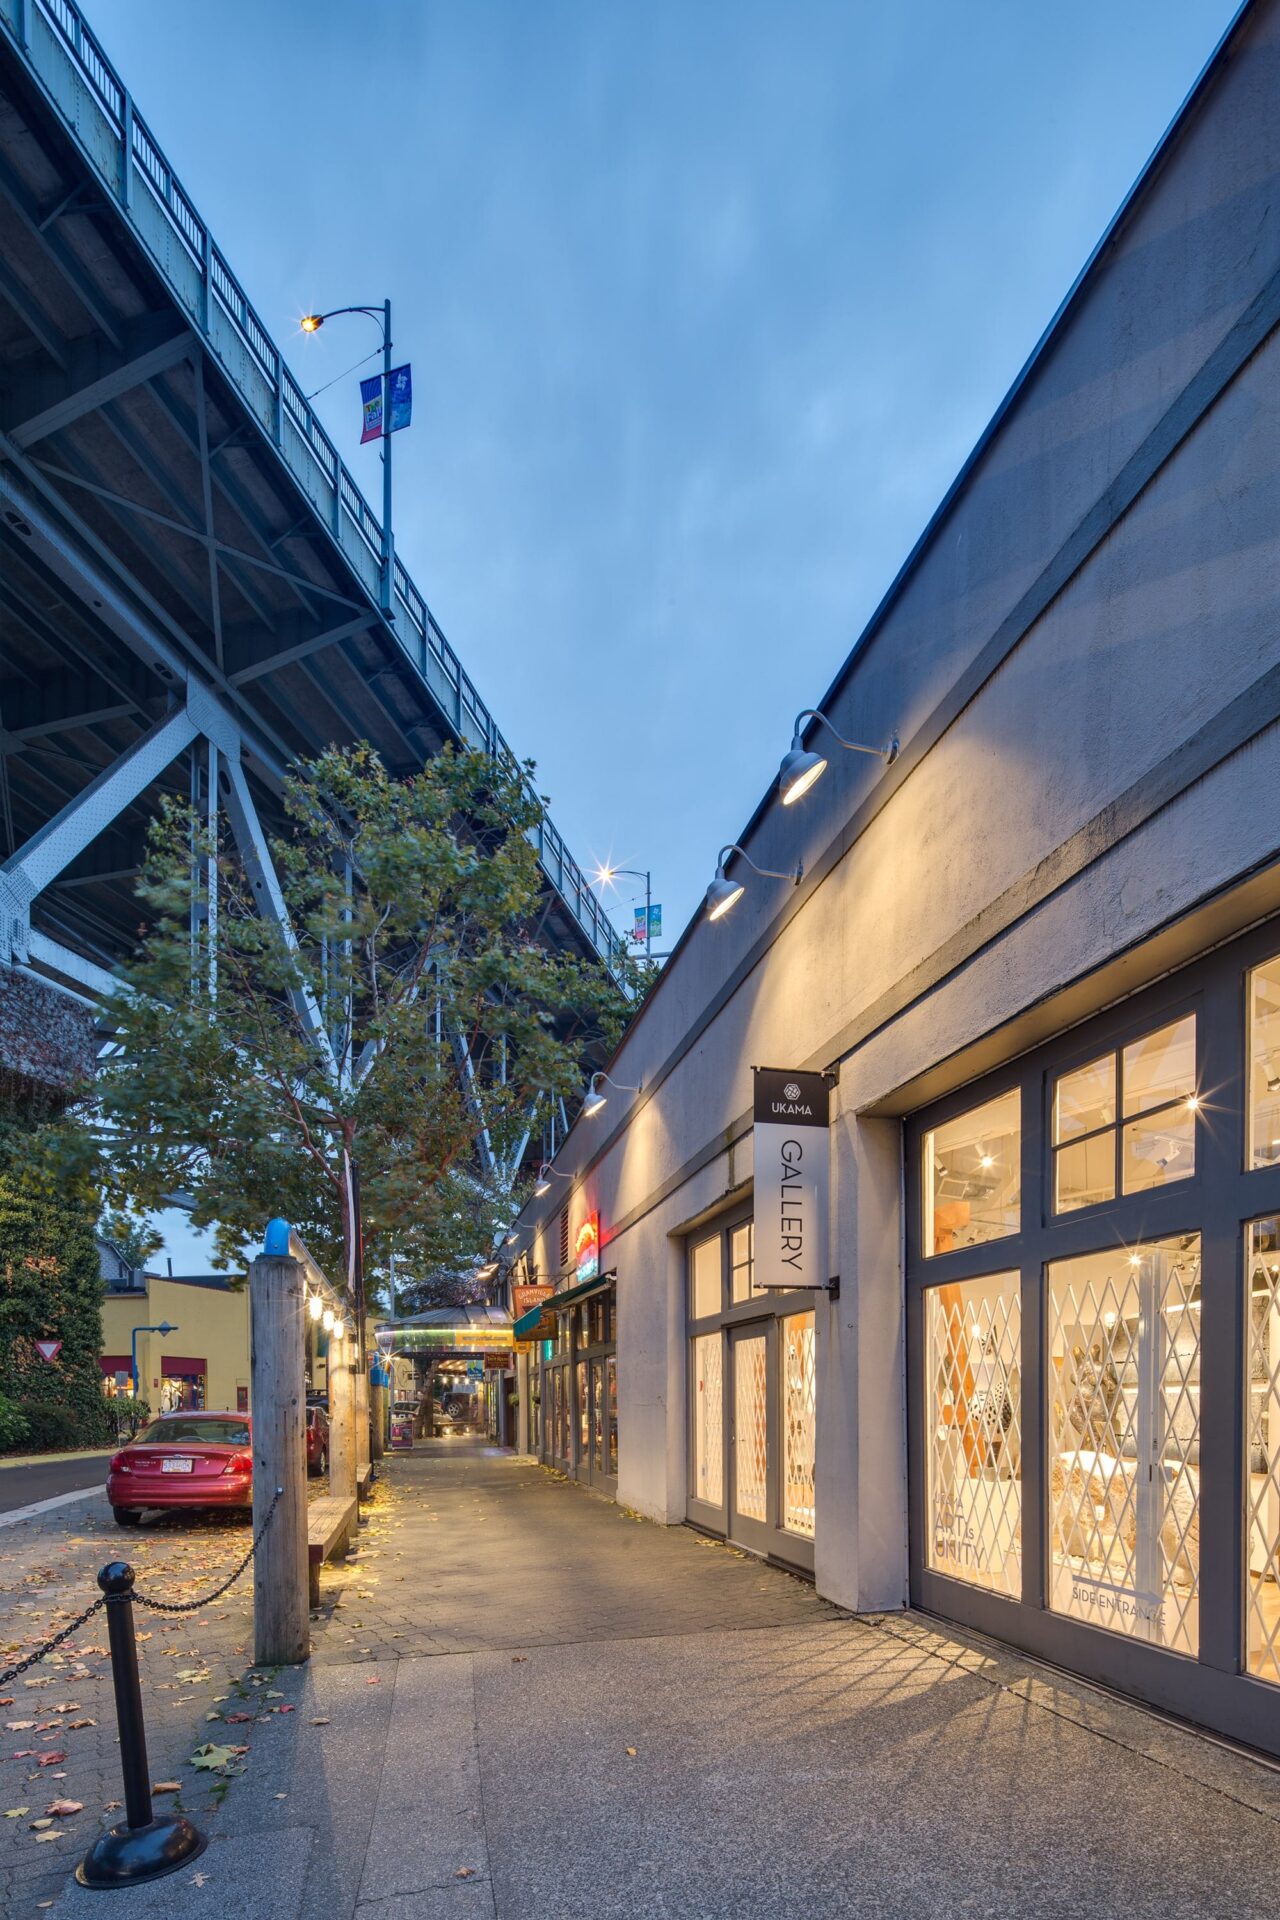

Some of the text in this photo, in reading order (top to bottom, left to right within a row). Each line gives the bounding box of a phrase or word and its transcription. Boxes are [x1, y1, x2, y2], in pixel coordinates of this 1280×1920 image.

[771, 1102, 812, 1116] UKAMA
[781, 1139, 803, 1271] GALLERY
[936, 1512, 964, 1536] ART
[935, 1536, 985, 1569] UNITY
[1072, 1586, 1166, 1626] SIDE ENTRANCE
